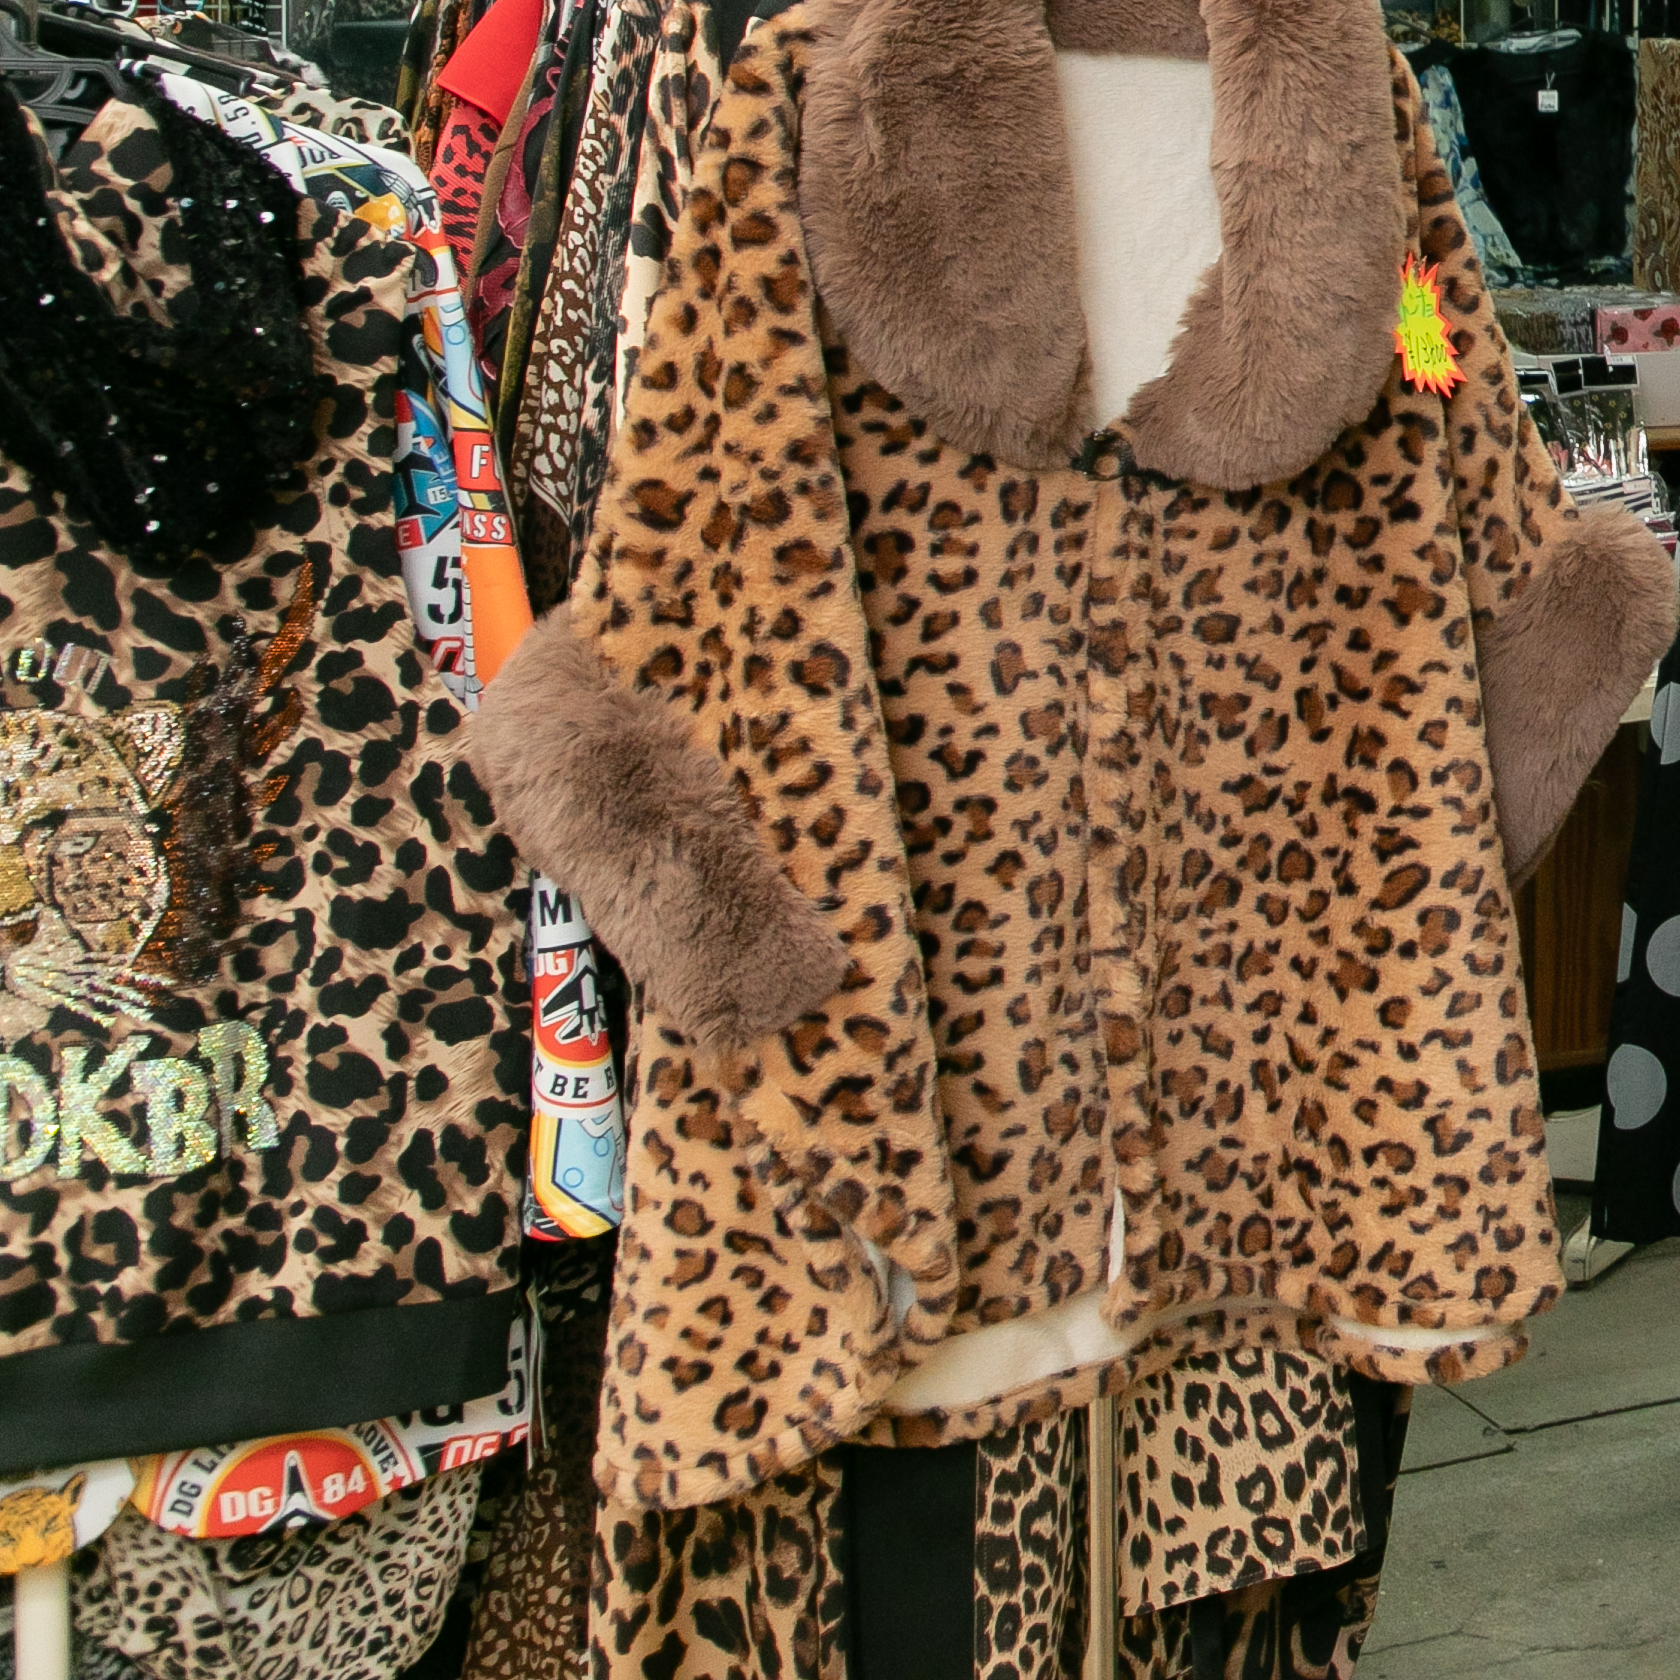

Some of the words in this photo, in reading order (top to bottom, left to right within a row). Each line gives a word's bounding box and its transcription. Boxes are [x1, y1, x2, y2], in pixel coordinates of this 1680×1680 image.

[550, 1074, 590, 1100] BE
[218, 1485, 277, 1526] DG
[321, 1463, 368, 1506] 84
